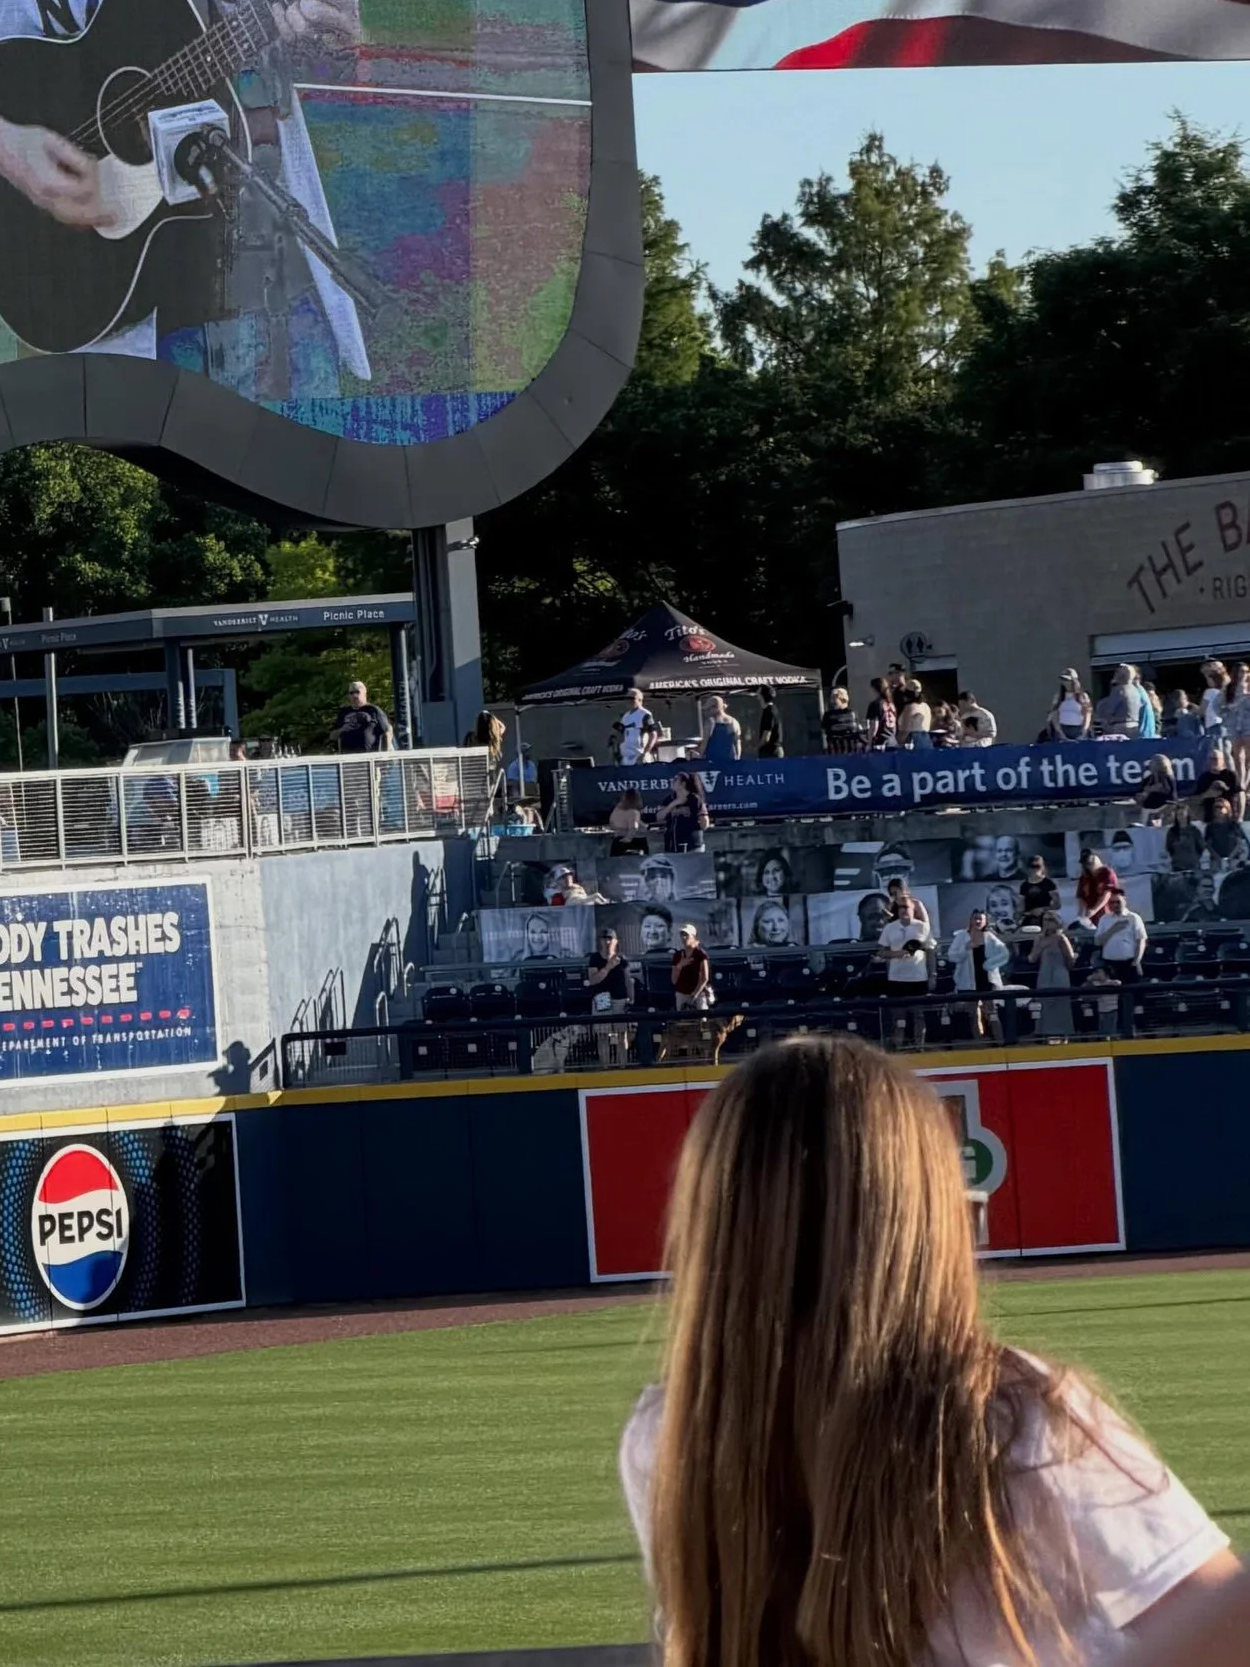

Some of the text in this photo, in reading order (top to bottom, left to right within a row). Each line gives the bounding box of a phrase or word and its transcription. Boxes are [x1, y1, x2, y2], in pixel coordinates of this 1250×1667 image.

[1127, 501, 1250, 613] THE B
[323, 609, 385, 621] Picnic Place
[664, 624, 706, 641] Tito's
[700, 677, 743, 688] ORIGINAL
[744, 676, 775, 685] CRAFT
[775, 675, 807, 684] VODKA
[724, 773, 785, 787] HEALTH
[827, 767, 872, 801] Be
[881, 774, 902, 797] a
[911, 762, 987, 802] part
[996, 756, 1032, 790] of
[1040, 754, 1097, 789] the
[53, 911, 181, 961] TRASHES
[72, 1035, 87, 1047] OF
[92, 1027, 192, 1046] TRANSPORTATION
[38, 1207, 124, 1247] PEPSI
